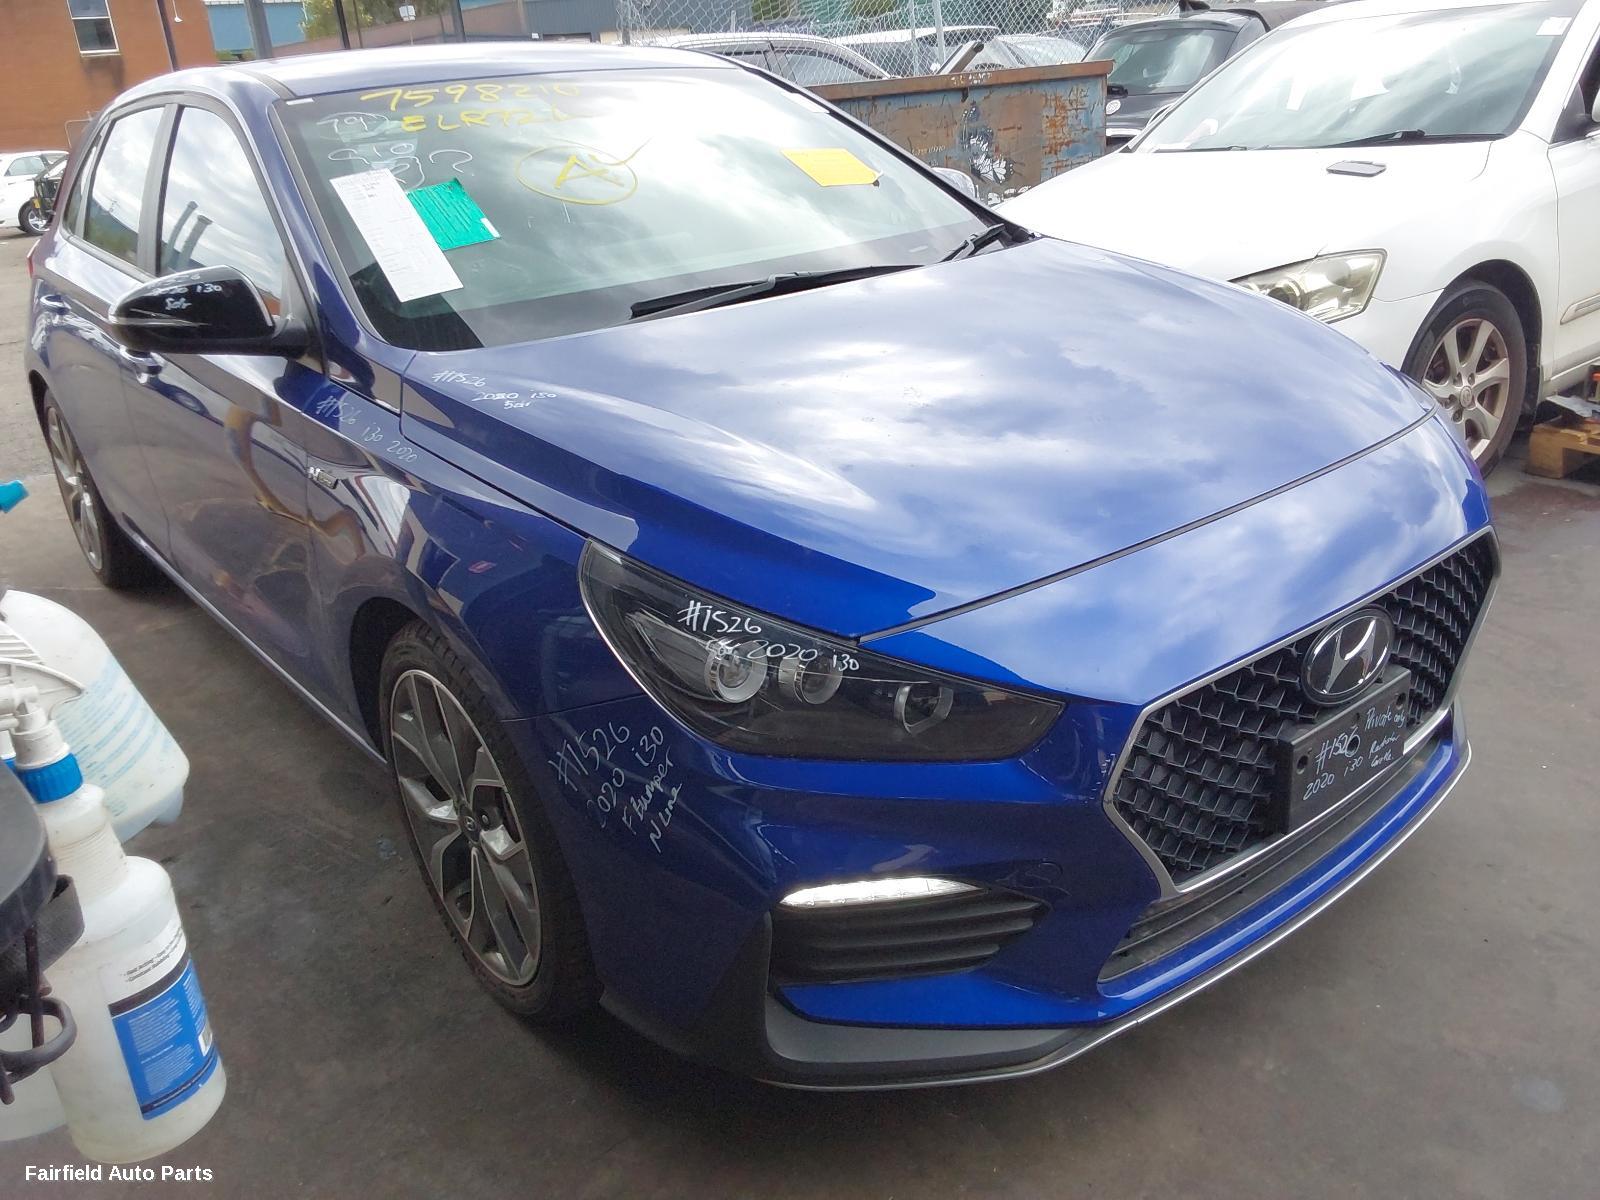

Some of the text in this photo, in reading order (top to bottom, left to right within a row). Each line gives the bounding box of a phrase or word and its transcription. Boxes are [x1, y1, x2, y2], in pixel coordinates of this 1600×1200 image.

[386, 440, 419, 463] 2020
[677, 599, 762, 633] #1526
[746, 639, 818, 661] 2020
[832, 648, 861, 672] i30
[547, 721, 630, 792] #1526
[631, 726, 664, 767] i30
[1315, 724, 1361, 775] #1526
[1302, 756, 1364, 801] 2020 i30
